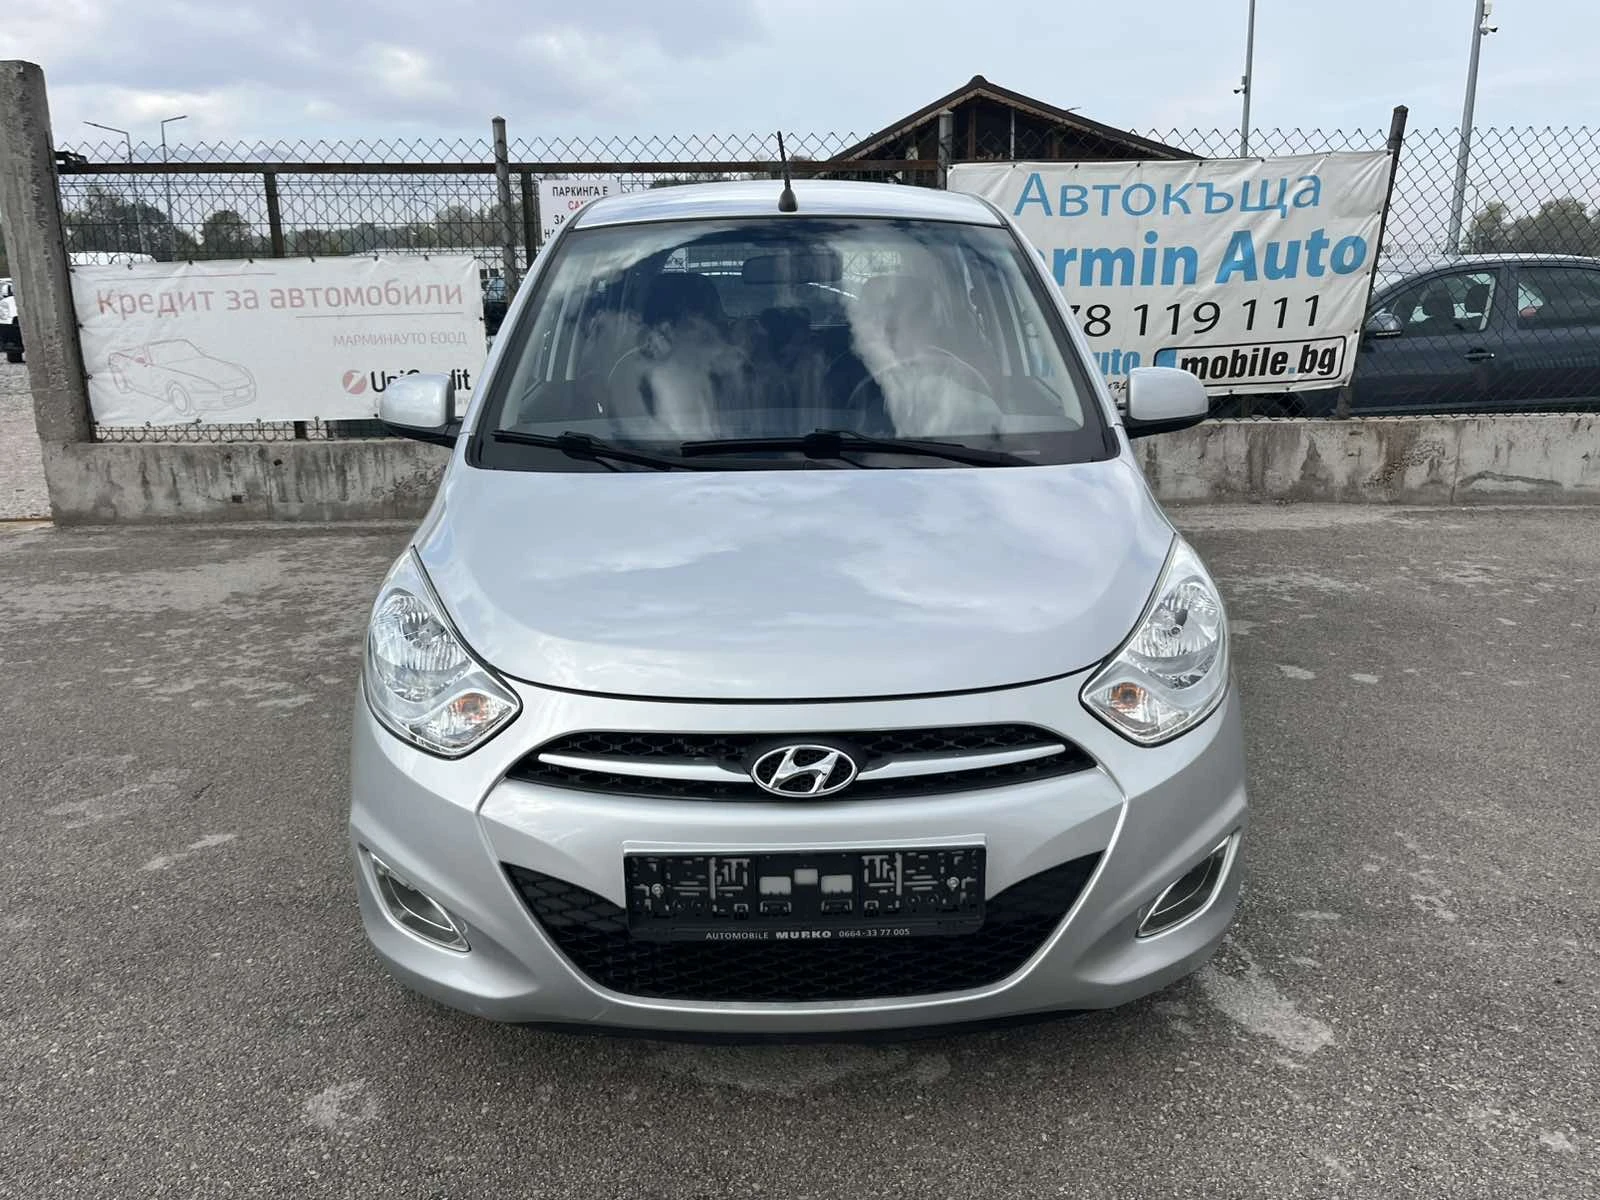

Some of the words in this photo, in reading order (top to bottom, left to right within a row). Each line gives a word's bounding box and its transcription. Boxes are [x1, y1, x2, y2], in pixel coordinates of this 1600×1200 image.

[552, 186, 600, 196] ПАРКИНГА
[1013, 173, 1322, 219] Автокъща
[1037, 230, 1199, 287] rmin
[1214, 228, 1367, 284] Auto
[225, 290, 259, 311] за
[270, 278, 463, 309] автомобили
[1133, 302, 1221, 336] 119
[1242, 294, 1320, 331] 111
[333, 333, 427, 346] МАРМИНАУТО
[1181, 344, 1337, 380] mobile.bg
[705, 931, 768, 939] AUTOMOBILE
[775, 930, 832, 939] MURKO
